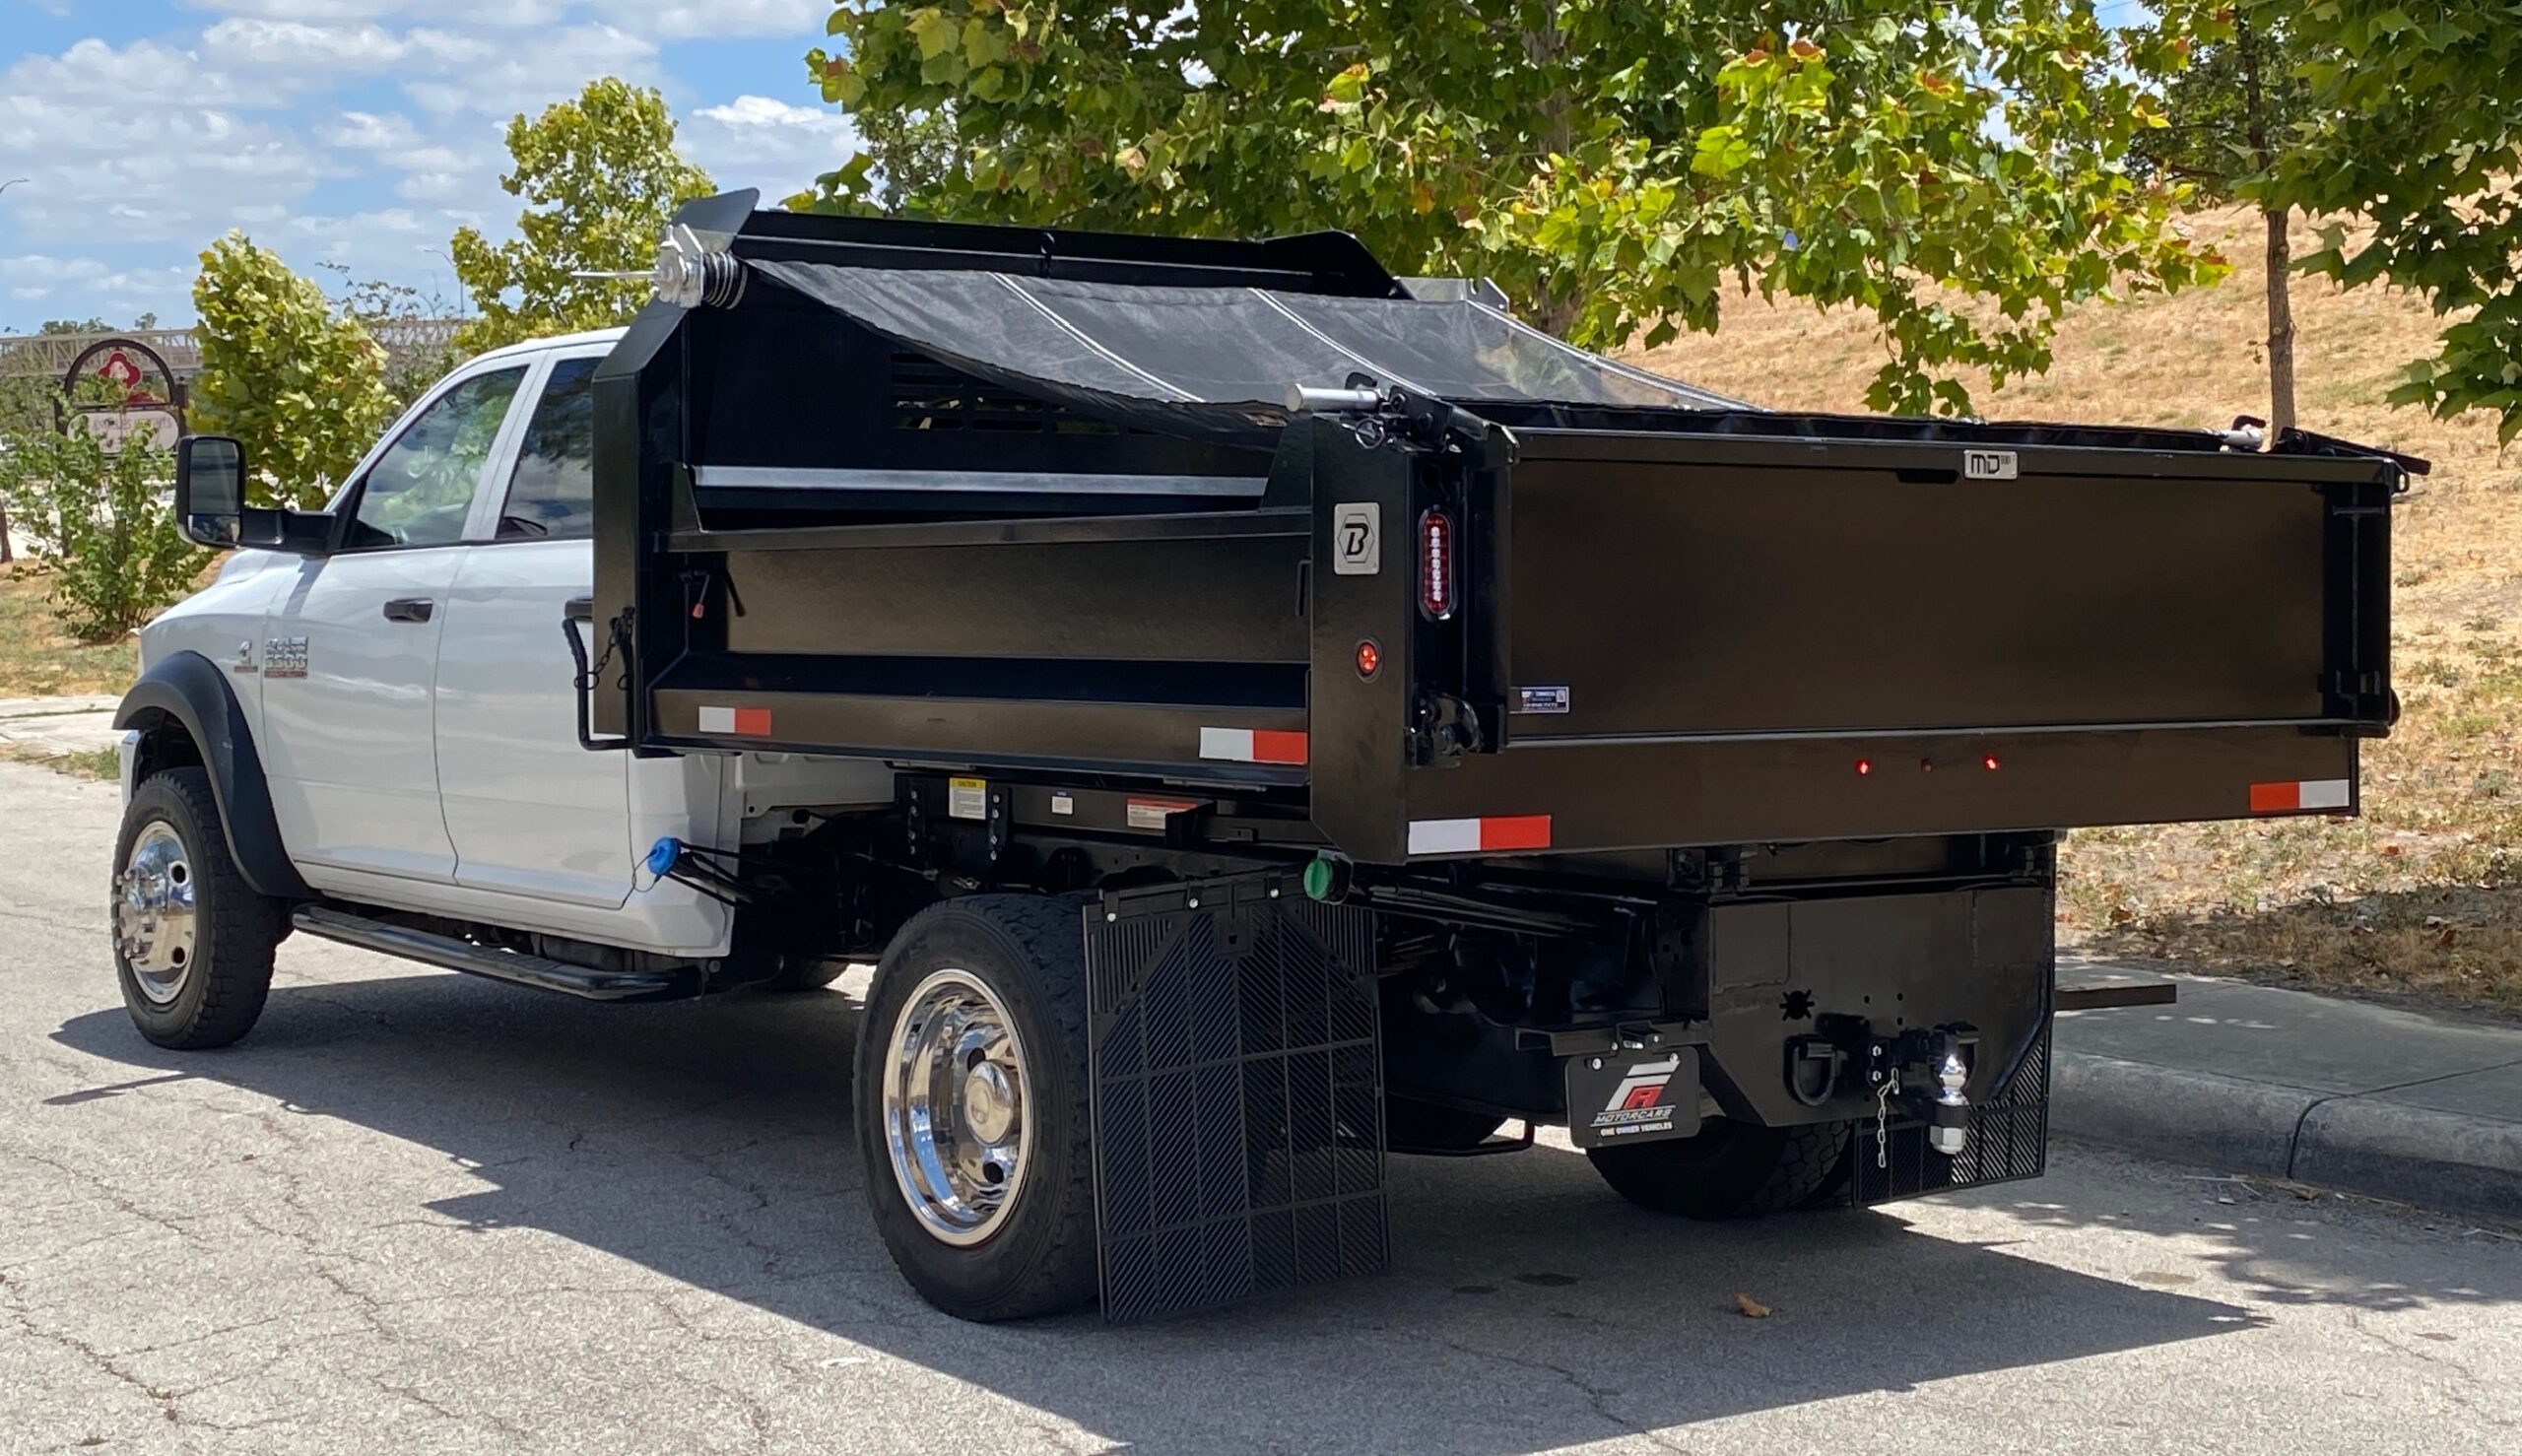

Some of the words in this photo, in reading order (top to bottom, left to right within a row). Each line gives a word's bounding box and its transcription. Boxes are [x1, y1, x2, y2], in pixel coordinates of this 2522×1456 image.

[1345, 523, 1368, 556] B
[1596, 1109, 1672, 1123] MOTORCARS
[1641, 1121, 1672, 1132] VEHICLES
